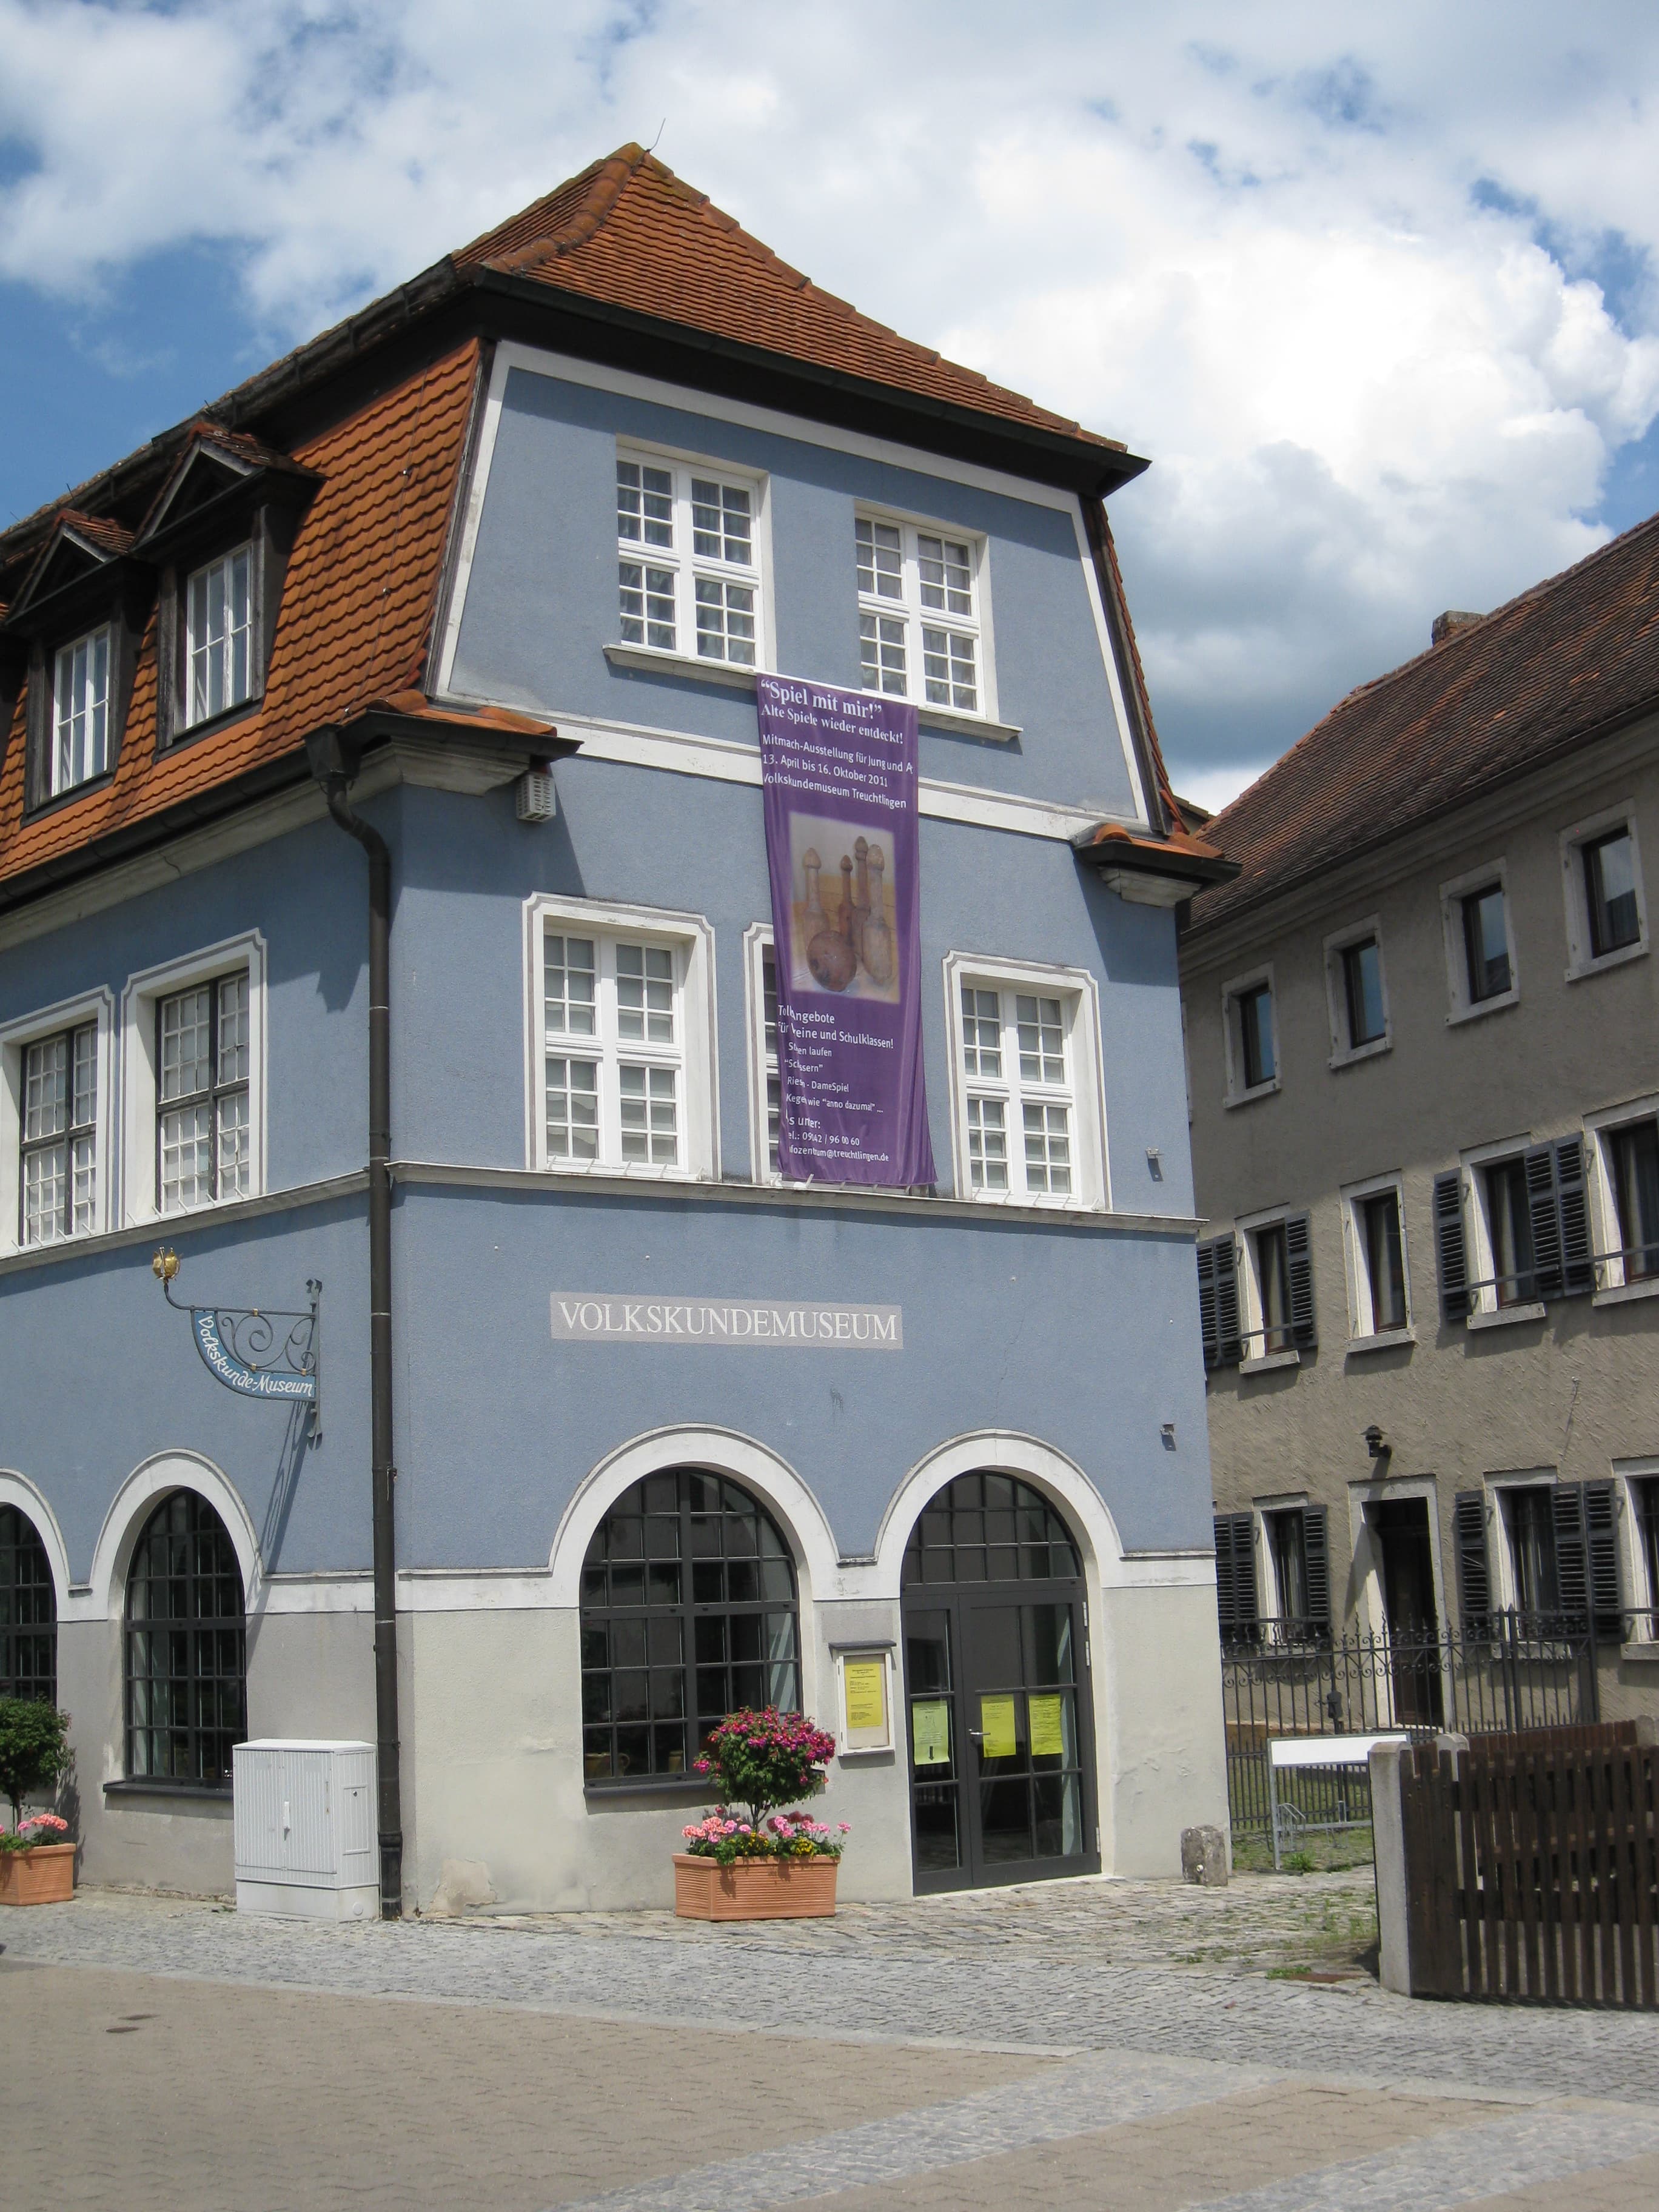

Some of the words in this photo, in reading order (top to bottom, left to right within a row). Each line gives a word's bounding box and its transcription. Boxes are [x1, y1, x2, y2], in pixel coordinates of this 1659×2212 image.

[812, 694, 838, 712] mit
[760, 704, 785, 718] Alte
[787, 709, 818, 726] Spiele
[820, 717, 857, 733] wieder
[859, 725, 903, 744] entdeckt!
[762, 734, 854, 764] Mitmach-Ausstellung
[856, 751, 867, 765] für
[868, 756, 886, 771] Jung
[886, 760, 903, 773] und
[762, 754, 779, 765] 13.
[780, 755, 800, 770] April
[802, 759, 816, 772] bis
[818, 763, 831, 776] 16.
[833, 766, 867, 783] Oktober
[868, 774, 888, 788] 2011
[763, 773, 850, 797] Volkskundemuseum
[852, 788, 907, 810] Treuchtlingen
[809, 1045, 833, 1057] laufen
[820, 1029, 837, 1041] und
[839, 1031, 894, 1049] Schulklassen!
[811, 1081, 850, 1093] DameSpiel
[808, 1098, 820, 1107] wie
[829, 1134, 840, 1144] 96
[851, 1136, 860, 1146] 60
[557, 1301, 899, 1341] VOLKSKUNDEMUSEUM
[196, 1315, 314, 1398] Volkskunde-Museum
